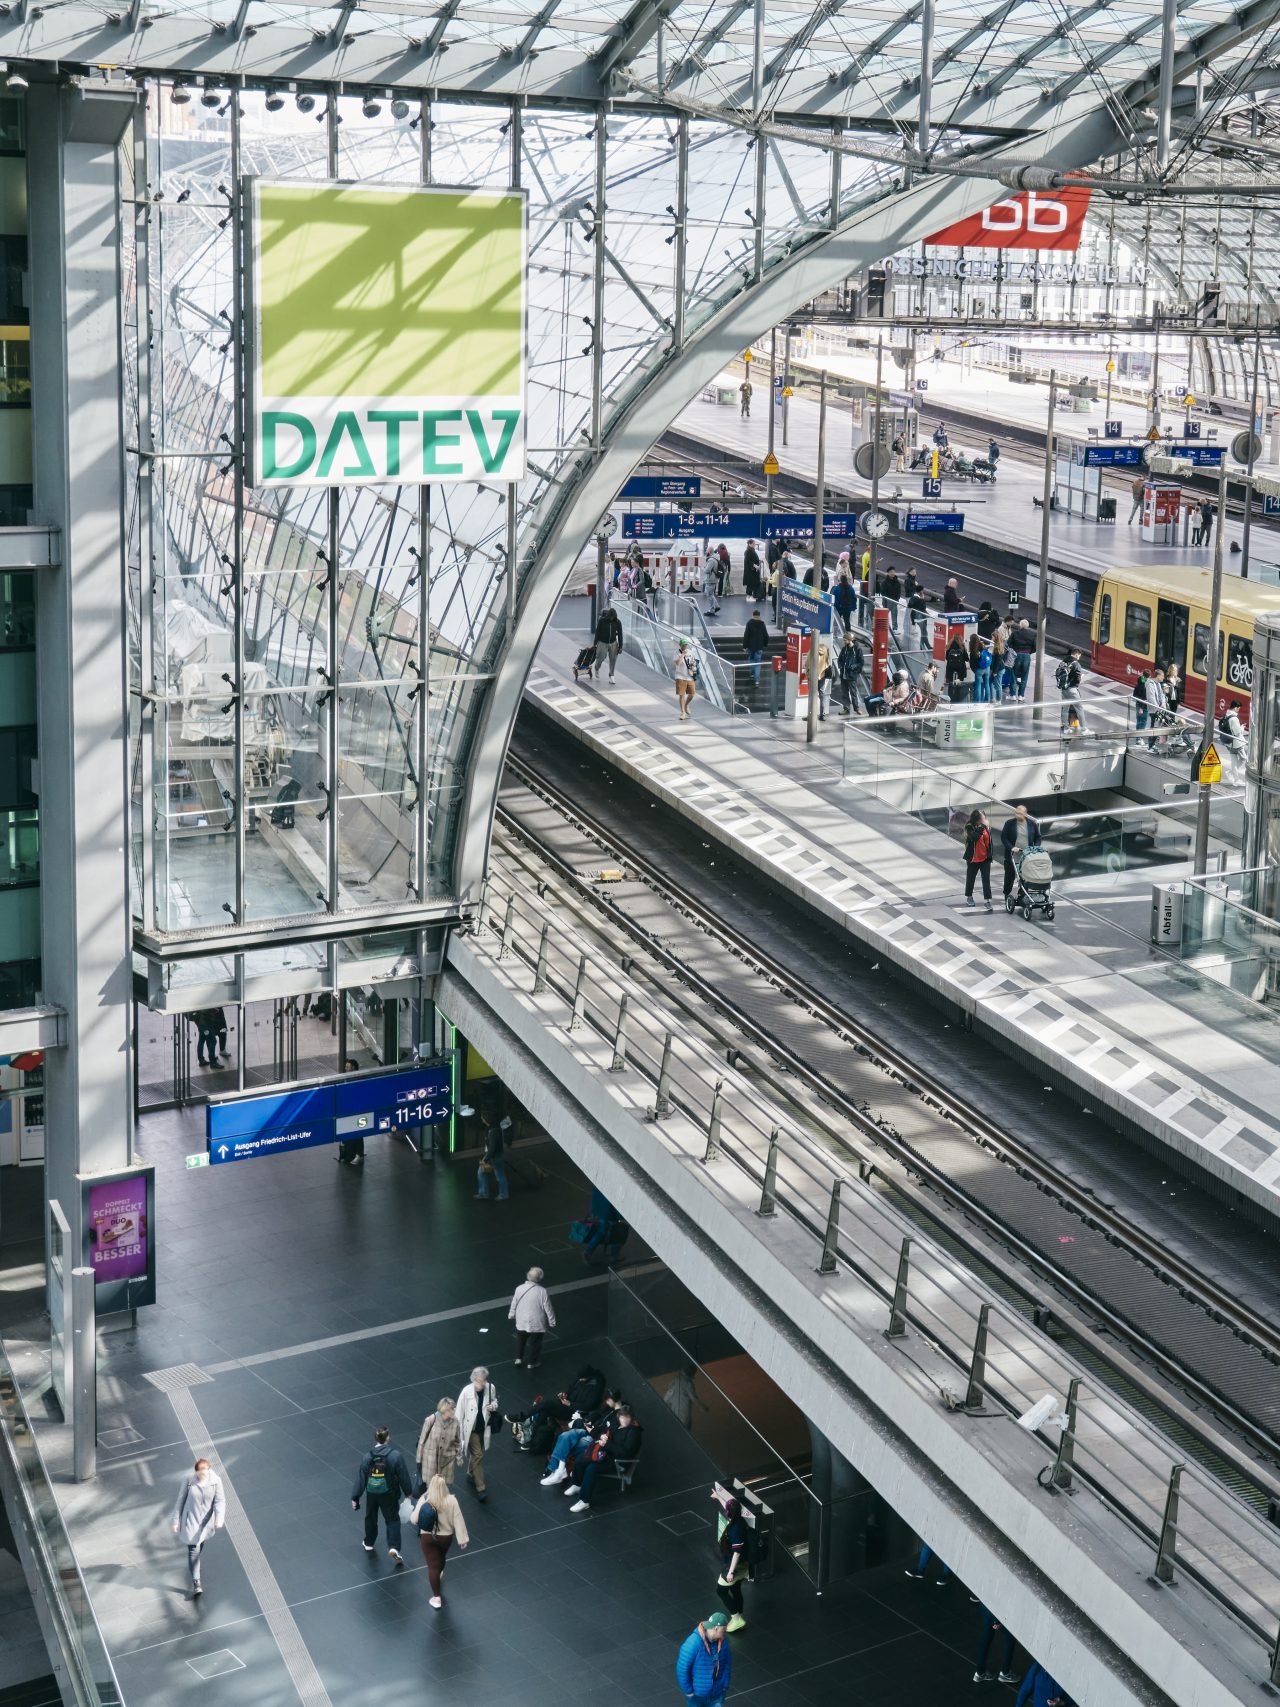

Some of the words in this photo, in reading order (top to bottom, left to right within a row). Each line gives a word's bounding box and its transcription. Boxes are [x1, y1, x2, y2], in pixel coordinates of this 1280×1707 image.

[933, 259, 999, 278] NICHT
[920, 379, 927, 388] G
[1176, 385, 1184, 395] G
[1107, 422, 1118, 434] 14
[1188, 423, 1199, 434] 13
[262, 410, 521, 479] DATEV
[722, 481, 728, 490] H
[926, 478, 941, 493] 15
[1268, 497, 1280, 509] 14
[678, 514, 695, 525] 1-8
[705, 514, 729, 525] 11-14
[782, 591, 794, 602] Berlin
[794, 595, 819, 614] Hauptbahnhof
[1010, 591, 1018, 602] H
[1163, 905, 1172, 936] Abfall
[396, 1103, 432, 1124] 11-16
[358, 1117, 367, 1128] S
[234, 1141, 260, 1151] Ausgang
[260, 1131, 312, 1146] Friedrich-List-Ufer
[93, 1202, 143, 1219] SCHMECKT
[110, 1217, 126, 1226] DUO
[94, 1244, 142, 1263] BESSER
